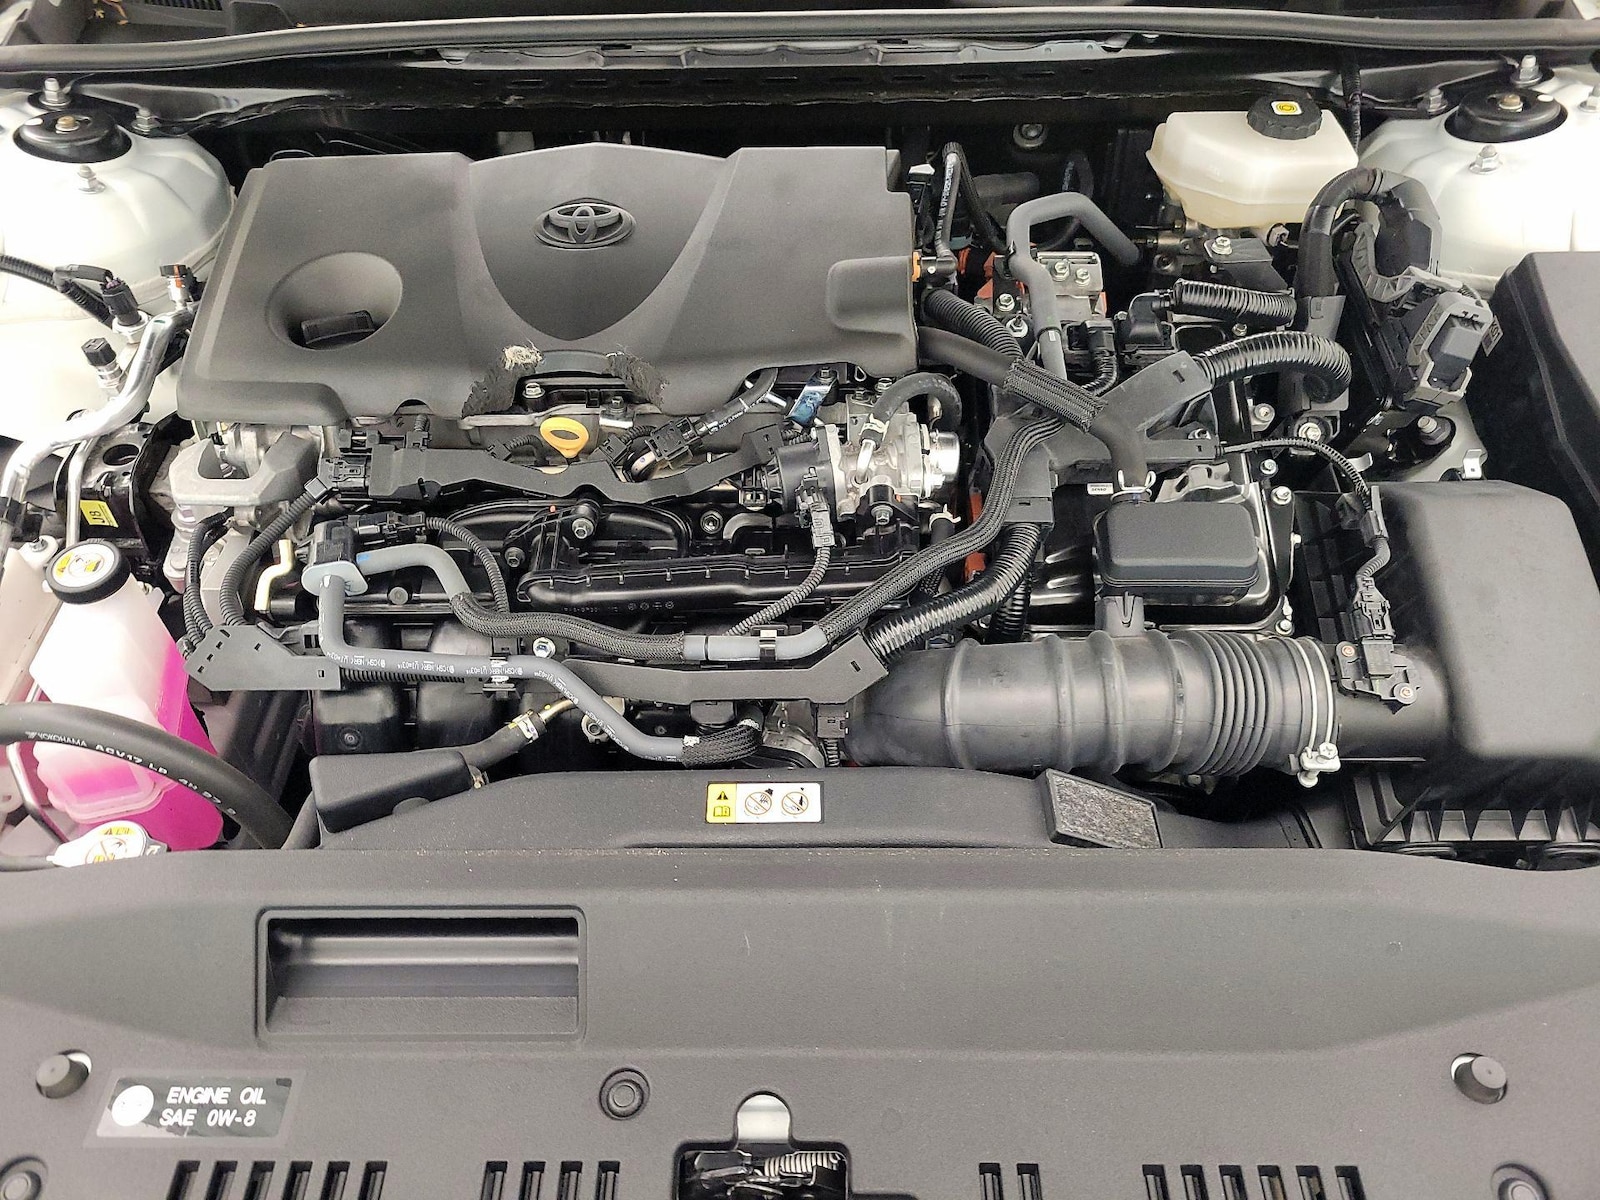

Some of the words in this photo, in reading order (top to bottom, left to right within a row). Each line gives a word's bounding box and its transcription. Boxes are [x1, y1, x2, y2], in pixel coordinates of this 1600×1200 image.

[37, 732, 88, 747] YOKOHAMA
[166, 1086, 231, 1105] ENGINE
[239, 1086, 267, 1105] OIL
[159, 1108, 198, 1127] SAE
[206, 1108, 257, 1127] 0W-8
